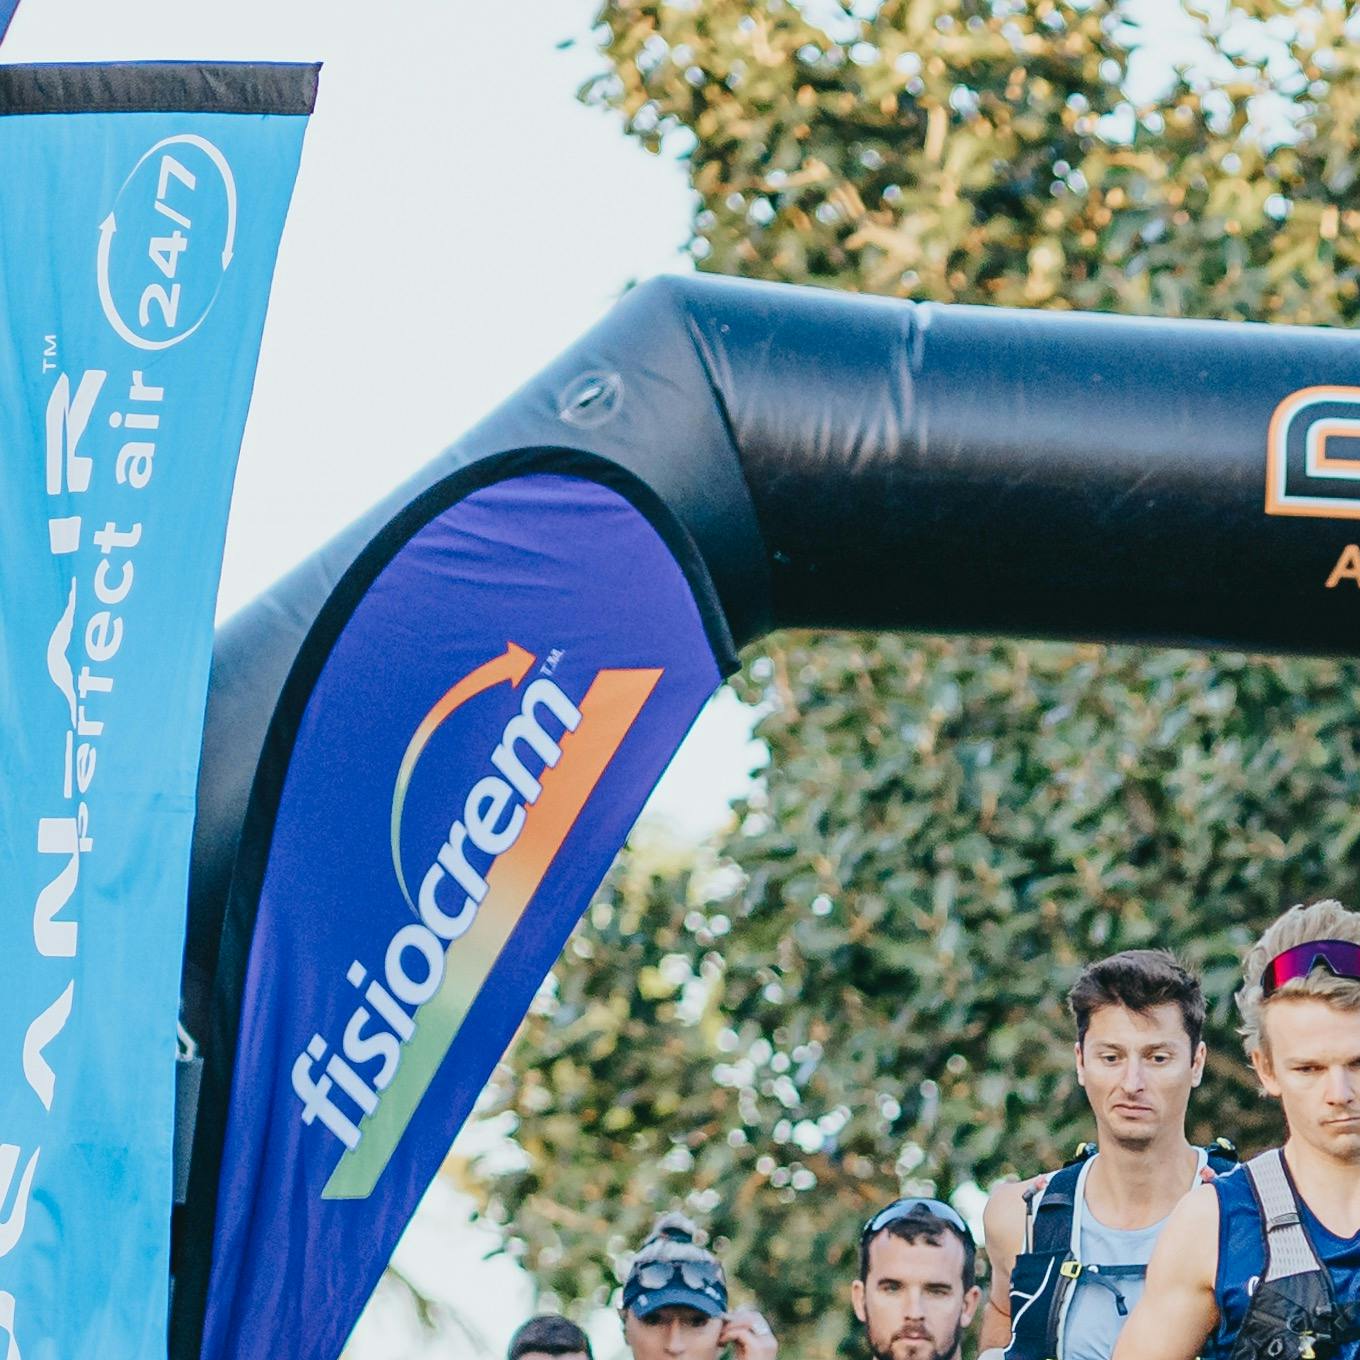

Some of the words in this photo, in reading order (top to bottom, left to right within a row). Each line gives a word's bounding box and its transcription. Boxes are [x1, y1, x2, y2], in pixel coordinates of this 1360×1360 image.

[138, 155, 197, 329] 24/7
[109, 369, 165, 489] air
[291, 678, 583, 1151] fisiocrem
